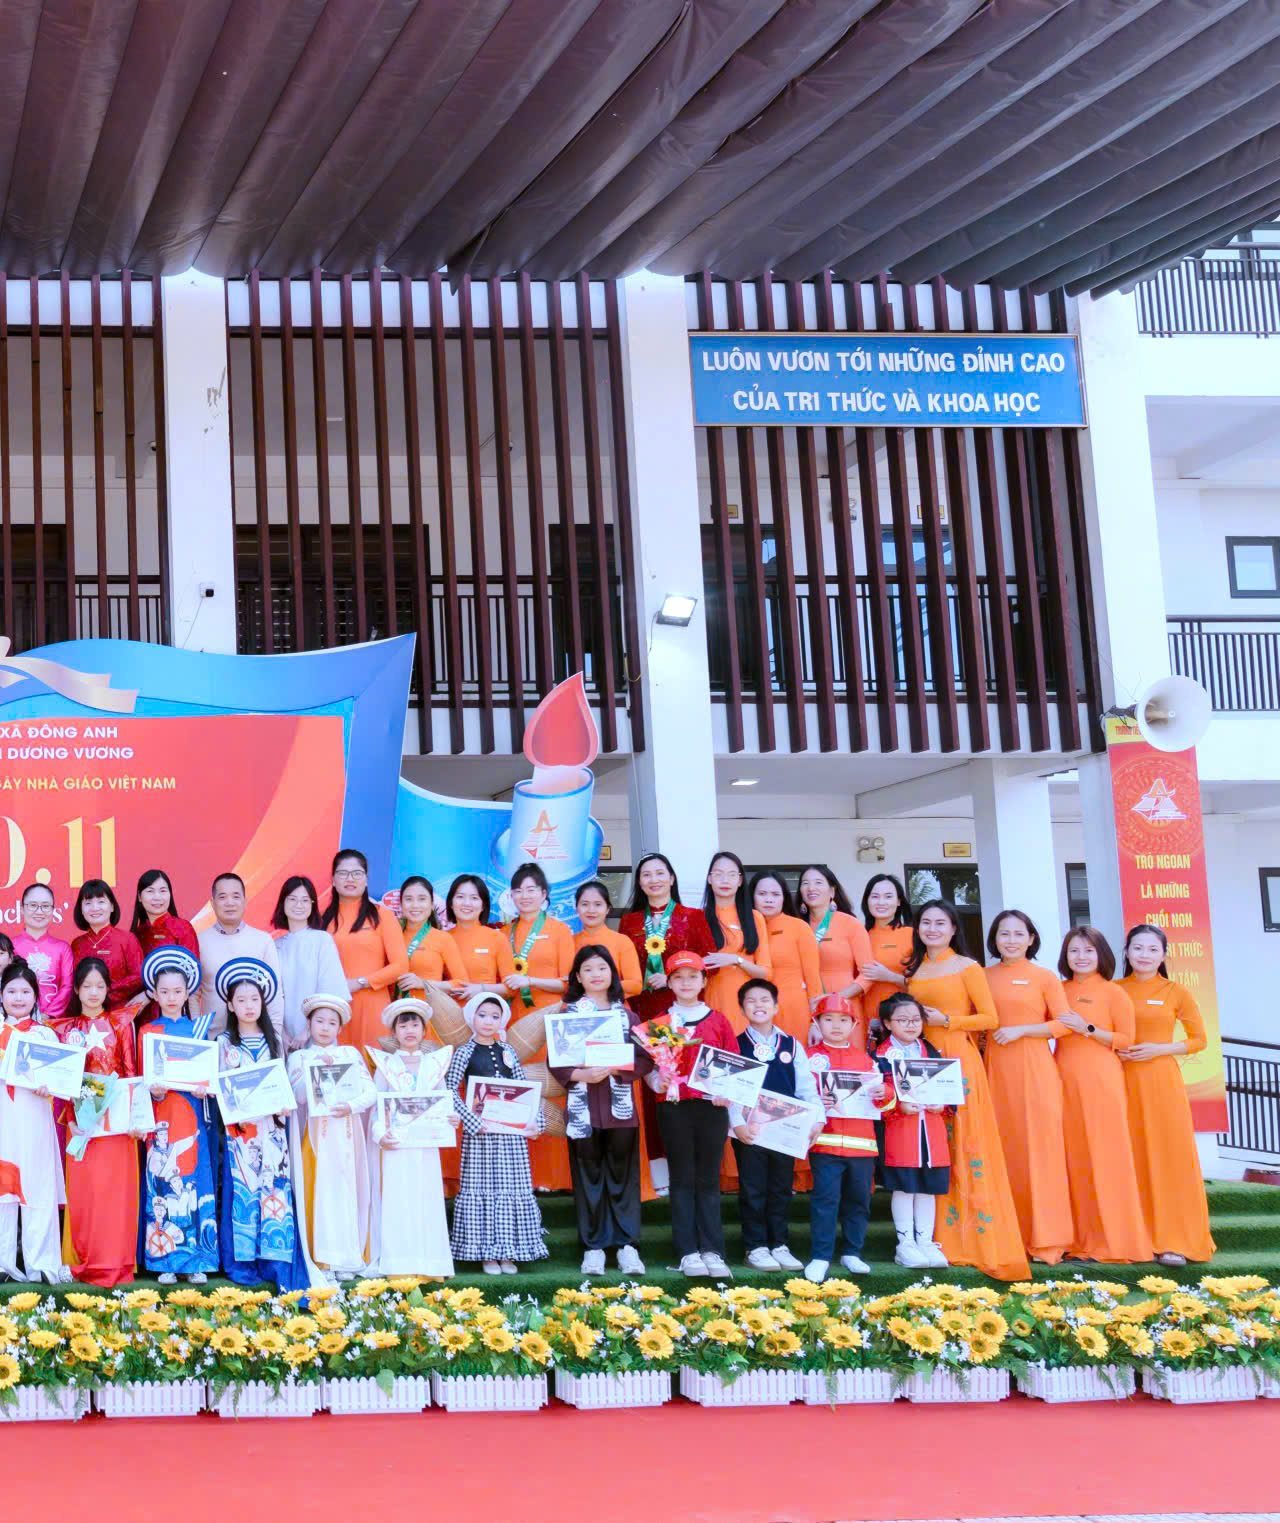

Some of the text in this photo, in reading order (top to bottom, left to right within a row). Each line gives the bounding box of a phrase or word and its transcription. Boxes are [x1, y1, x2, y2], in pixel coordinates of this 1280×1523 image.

[702, 345, 1066, 373] LUÔN VƯƠN TỚI NHỮNG ĐỈNH CAO
[732, 383, 1041, 417] CỦA TRI THỨC VÀ KHOA HỌC
[0, 724, 22, 739] XÃ
[27, 725, 78, 739] ĐÔNG
[83, 727, 118, 739] ANH
[7, 746, 69, 760] DƯƠNG
[74, 746, 134, 760] VƯƠNG
[63, 775, 103, 790] GIÁO
[141, 778, 176, 790] NAM
[1156, 854, 1191, 869] NGOAN
[1141, 881, 1154, 899] LÀ
[1171, 912, 1193, 928] NON
